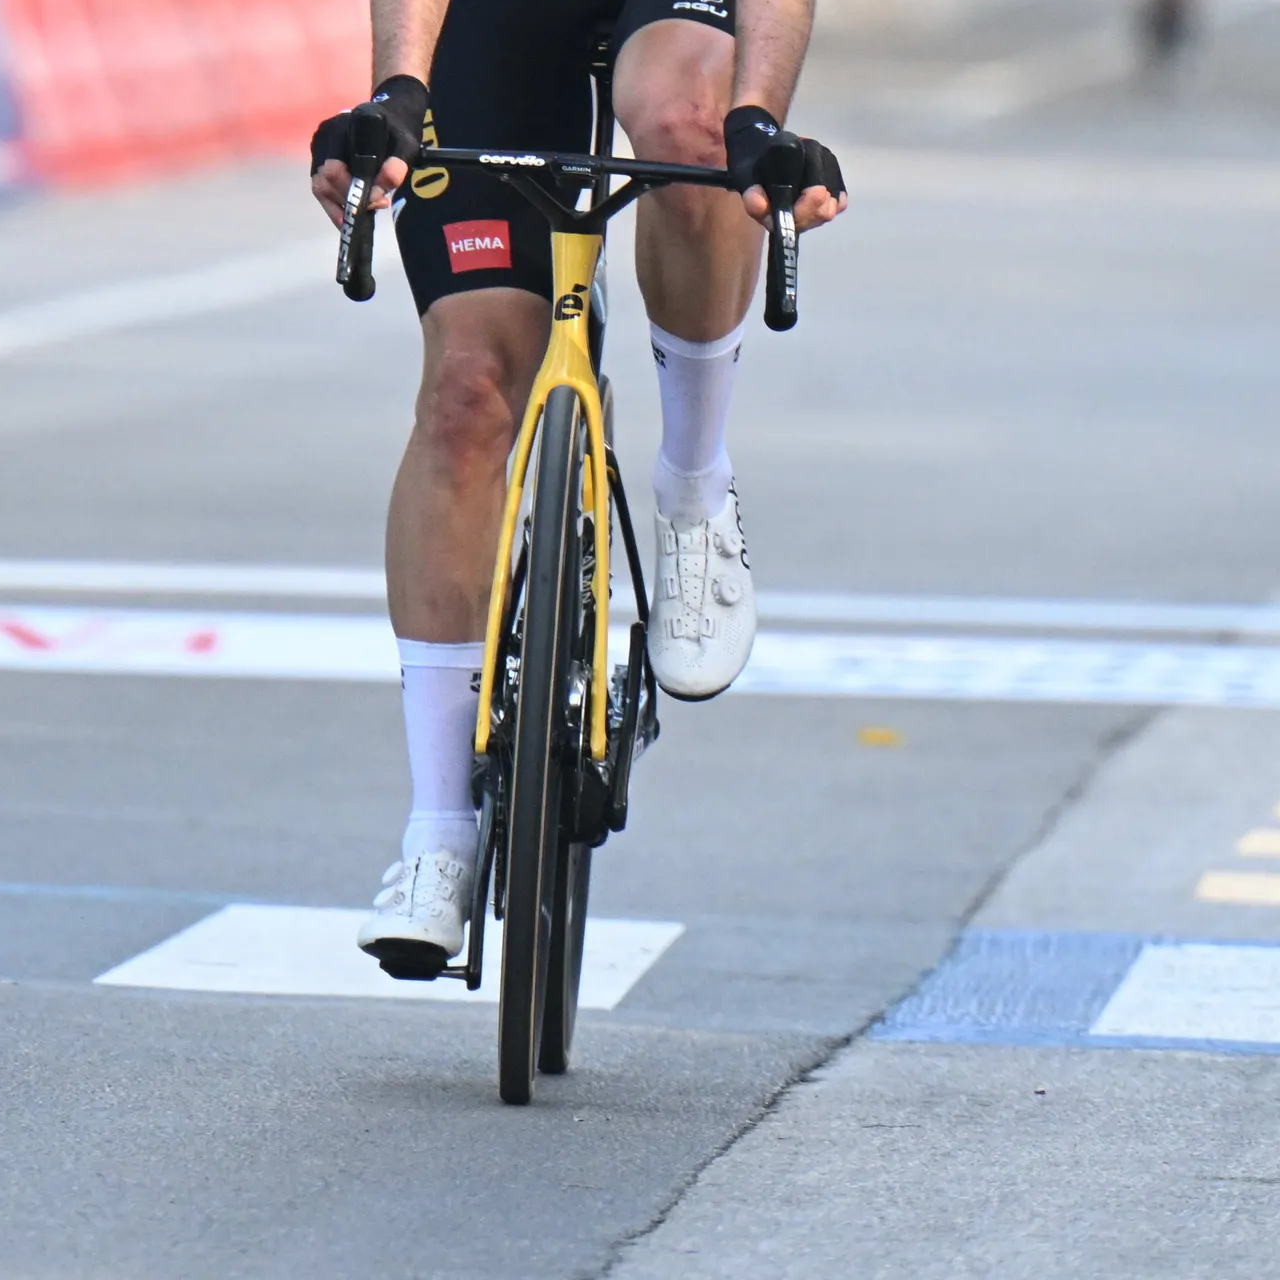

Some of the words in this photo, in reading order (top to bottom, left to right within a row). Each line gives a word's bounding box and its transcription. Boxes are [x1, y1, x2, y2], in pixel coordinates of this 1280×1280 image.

[673, 2, 728, 18] AGU
[562, 165, 591, 173] GARMIN
[339, 177, 365, 262] SRAM
[451, 236, 504, 254] HEMA
[779, 210, 797, 295] SRAM
